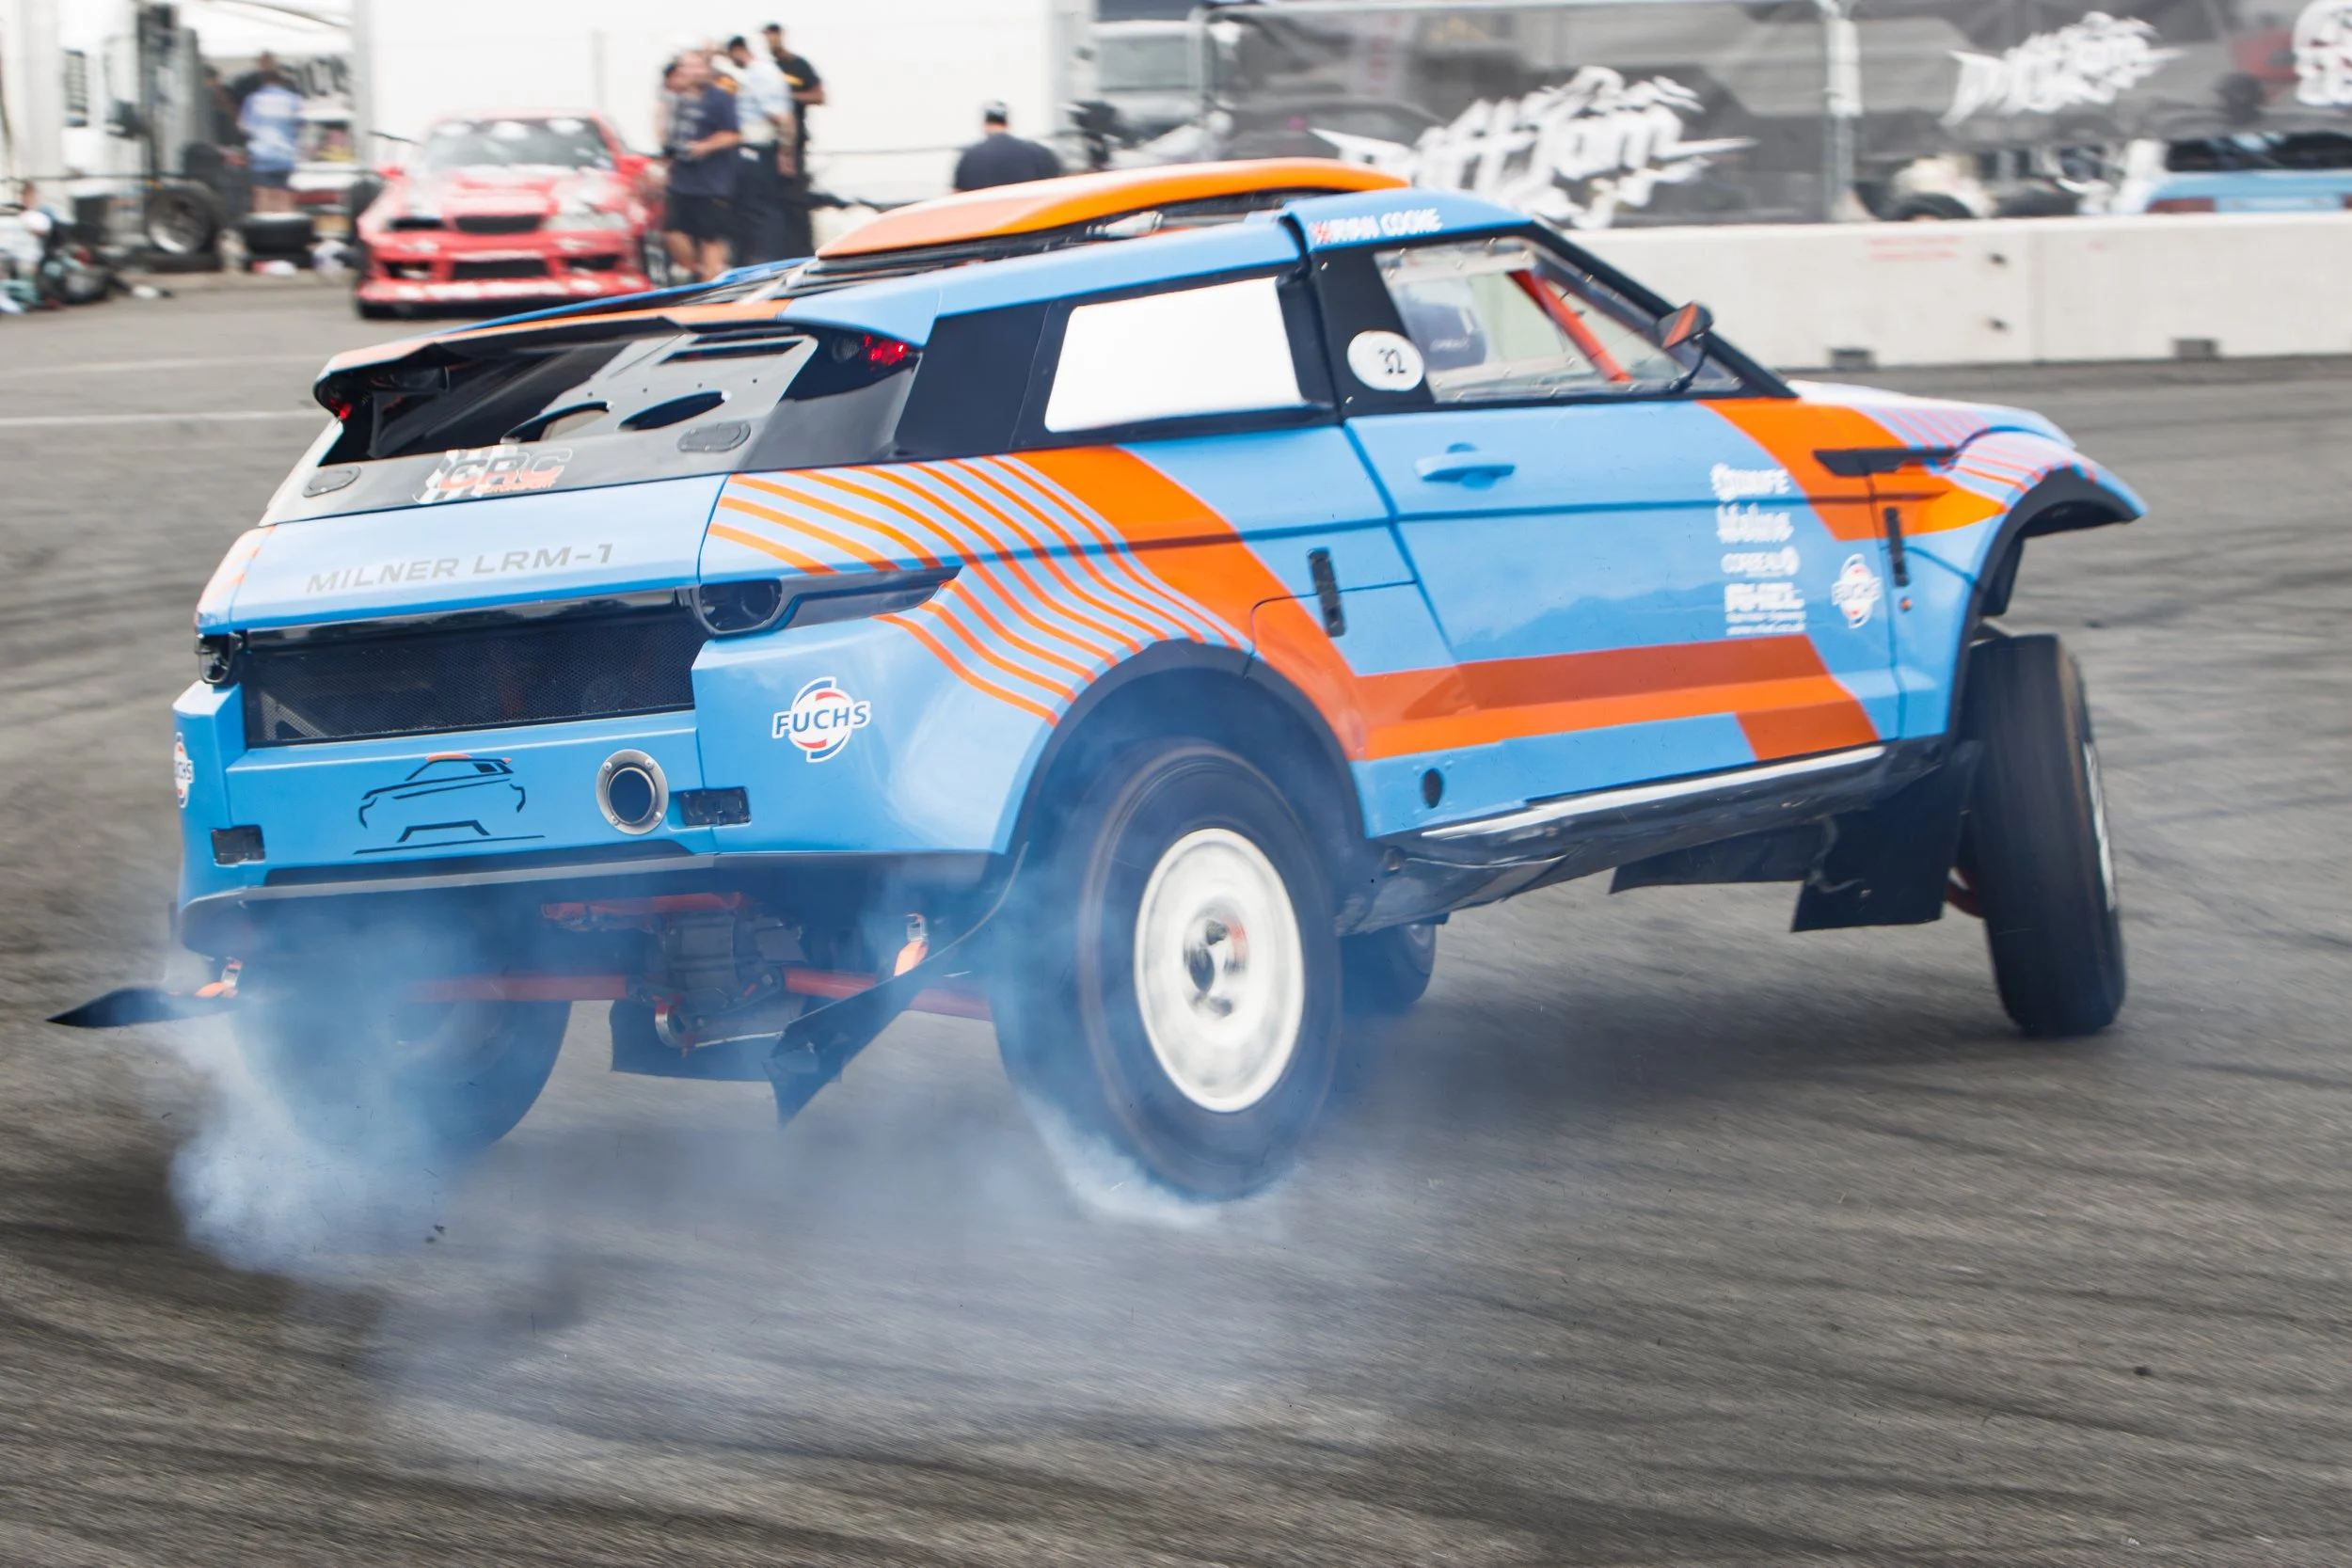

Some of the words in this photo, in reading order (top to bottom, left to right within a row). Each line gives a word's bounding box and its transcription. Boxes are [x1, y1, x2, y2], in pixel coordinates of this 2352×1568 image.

[306, 557, 459, 594] MILNER
[472, 543, 614, 576] LRM-1
[775, 703, 867, 736] FUCHS
